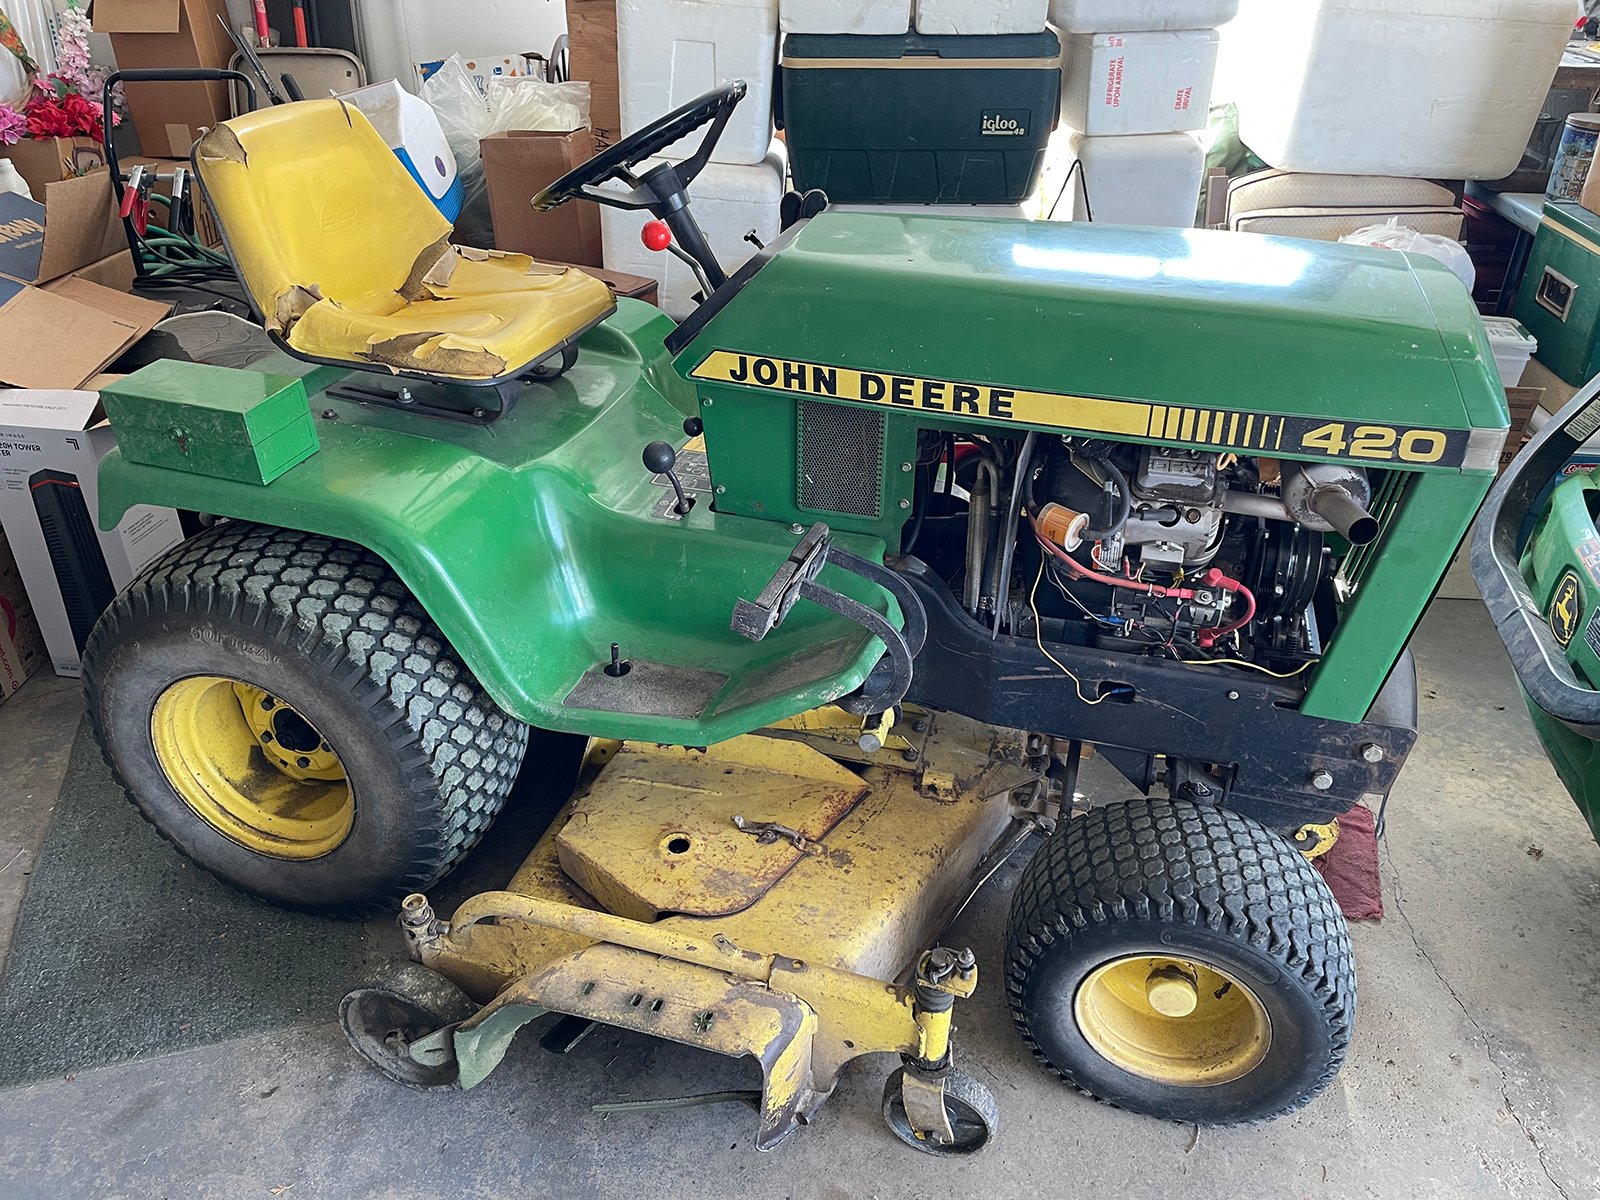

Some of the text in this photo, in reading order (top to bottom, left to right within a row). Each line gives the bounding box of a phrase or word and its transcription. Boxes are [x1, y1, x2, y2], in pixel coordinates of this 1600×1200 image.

[1106, 59, 1117, 105] REFRIGERATE
[1112, 56, 1125, 107] UPON ARRIVAL
[1174, 88, 1184, 110] ERATE
[982, 114, 1025, 135] igloo 48
[729, 355, 1015, 419] JOHN DEERE
[15, 443, 41, 452] TOWER
[1301, 422, 1447, 463] 420
